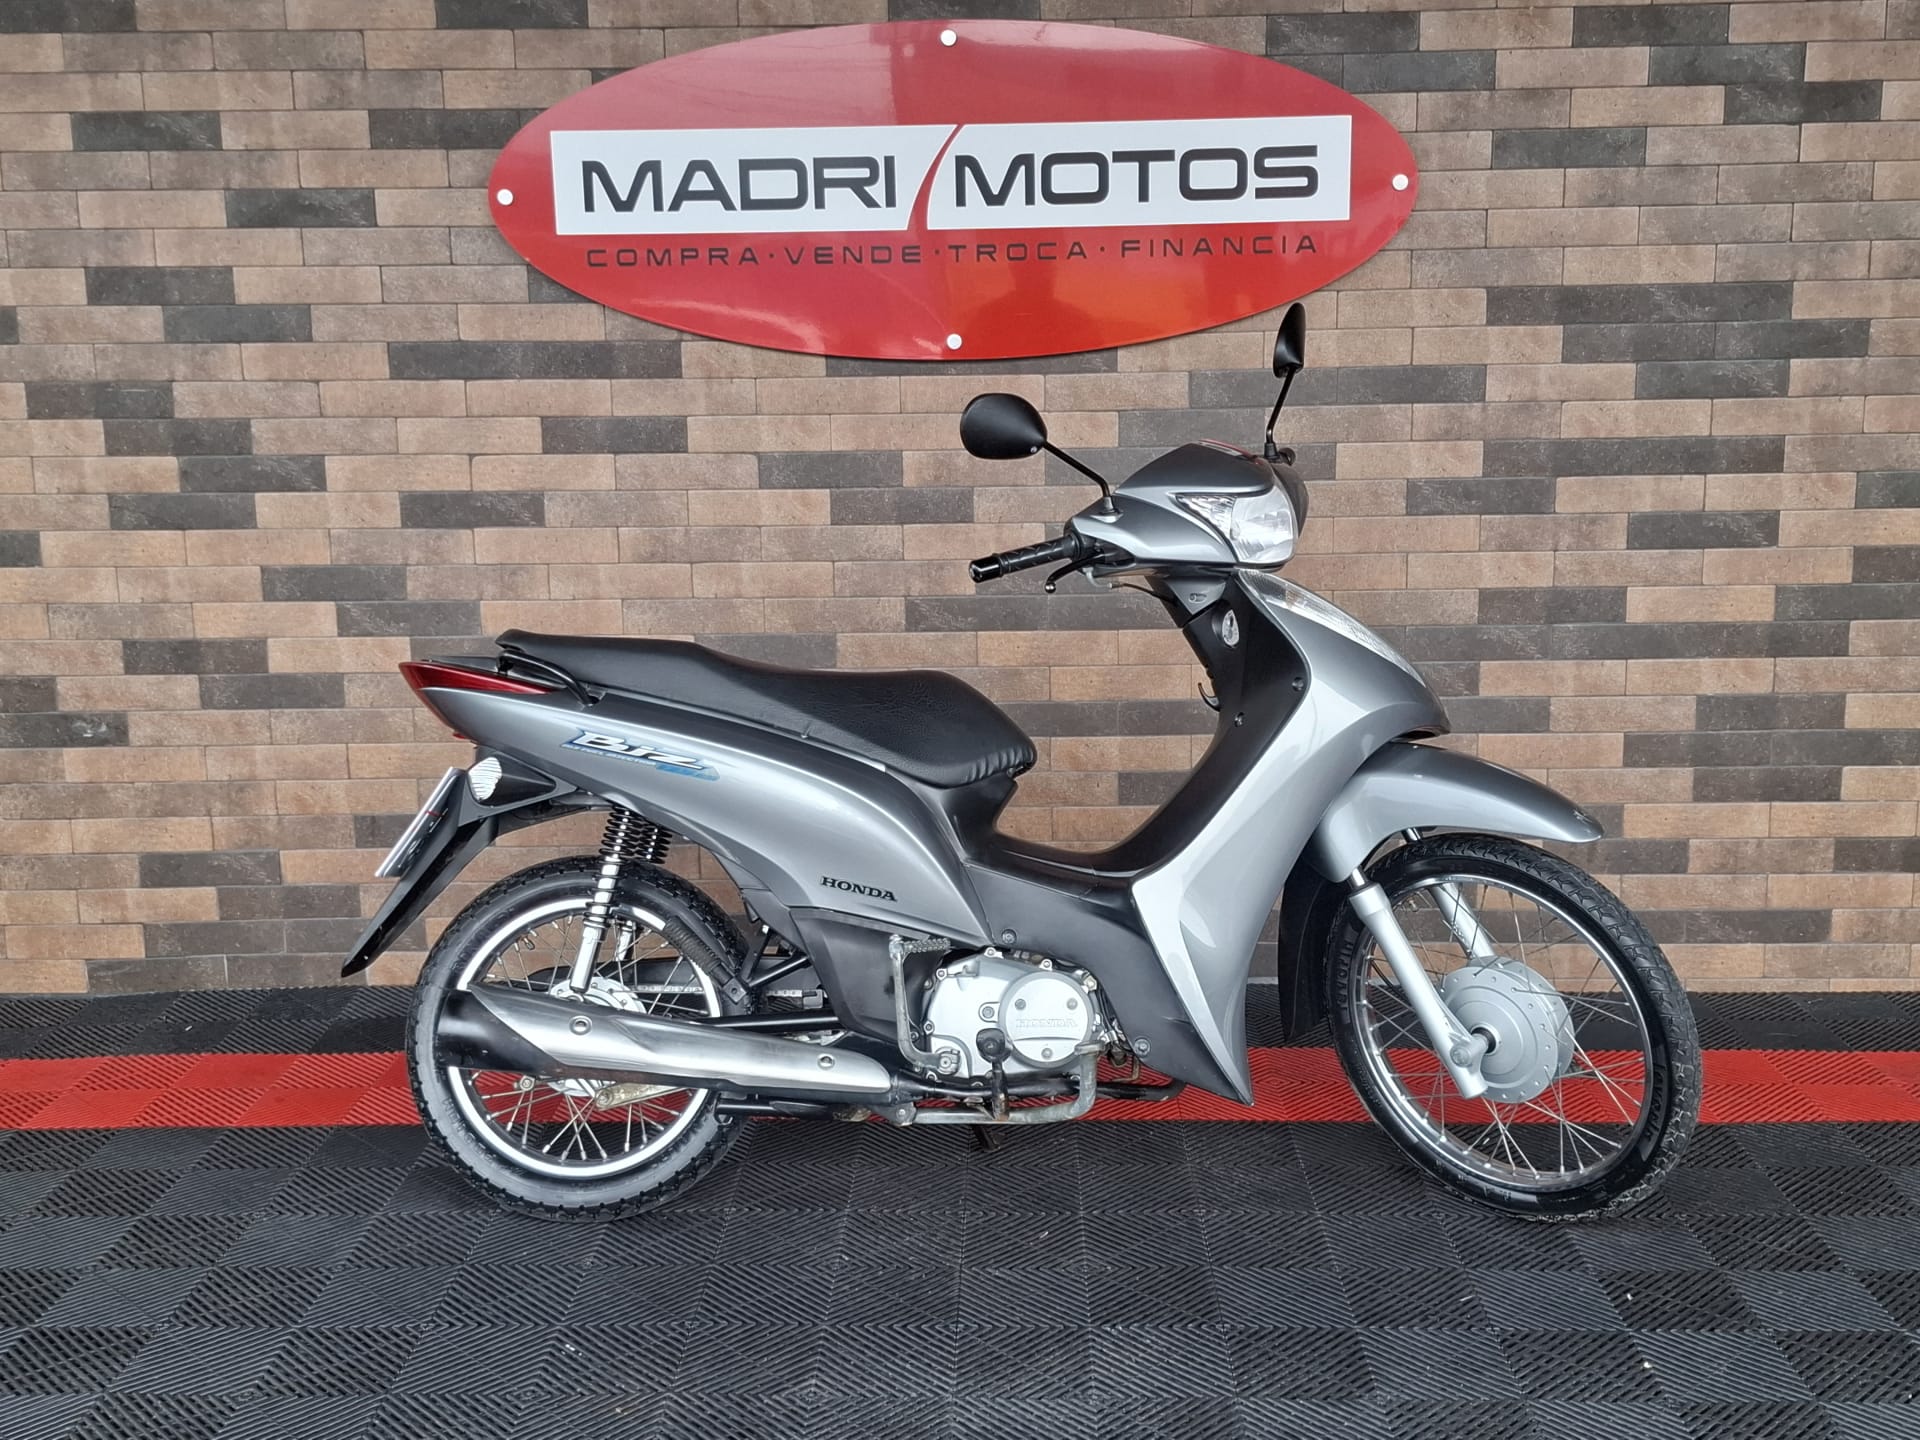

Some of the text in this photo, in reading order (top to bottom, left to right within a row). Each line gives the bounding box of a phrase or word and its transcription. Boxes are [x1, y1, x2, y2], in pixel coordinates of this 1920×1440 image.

[582, 145, 1318, 212] MADRI MOTOS
[587, 235, 1317, 267] COMPRA VENDE TROCA FINANCIA
[821, 876, 898, 902] HONDA
[1015, 1018, 1078, 1028] HONDA
